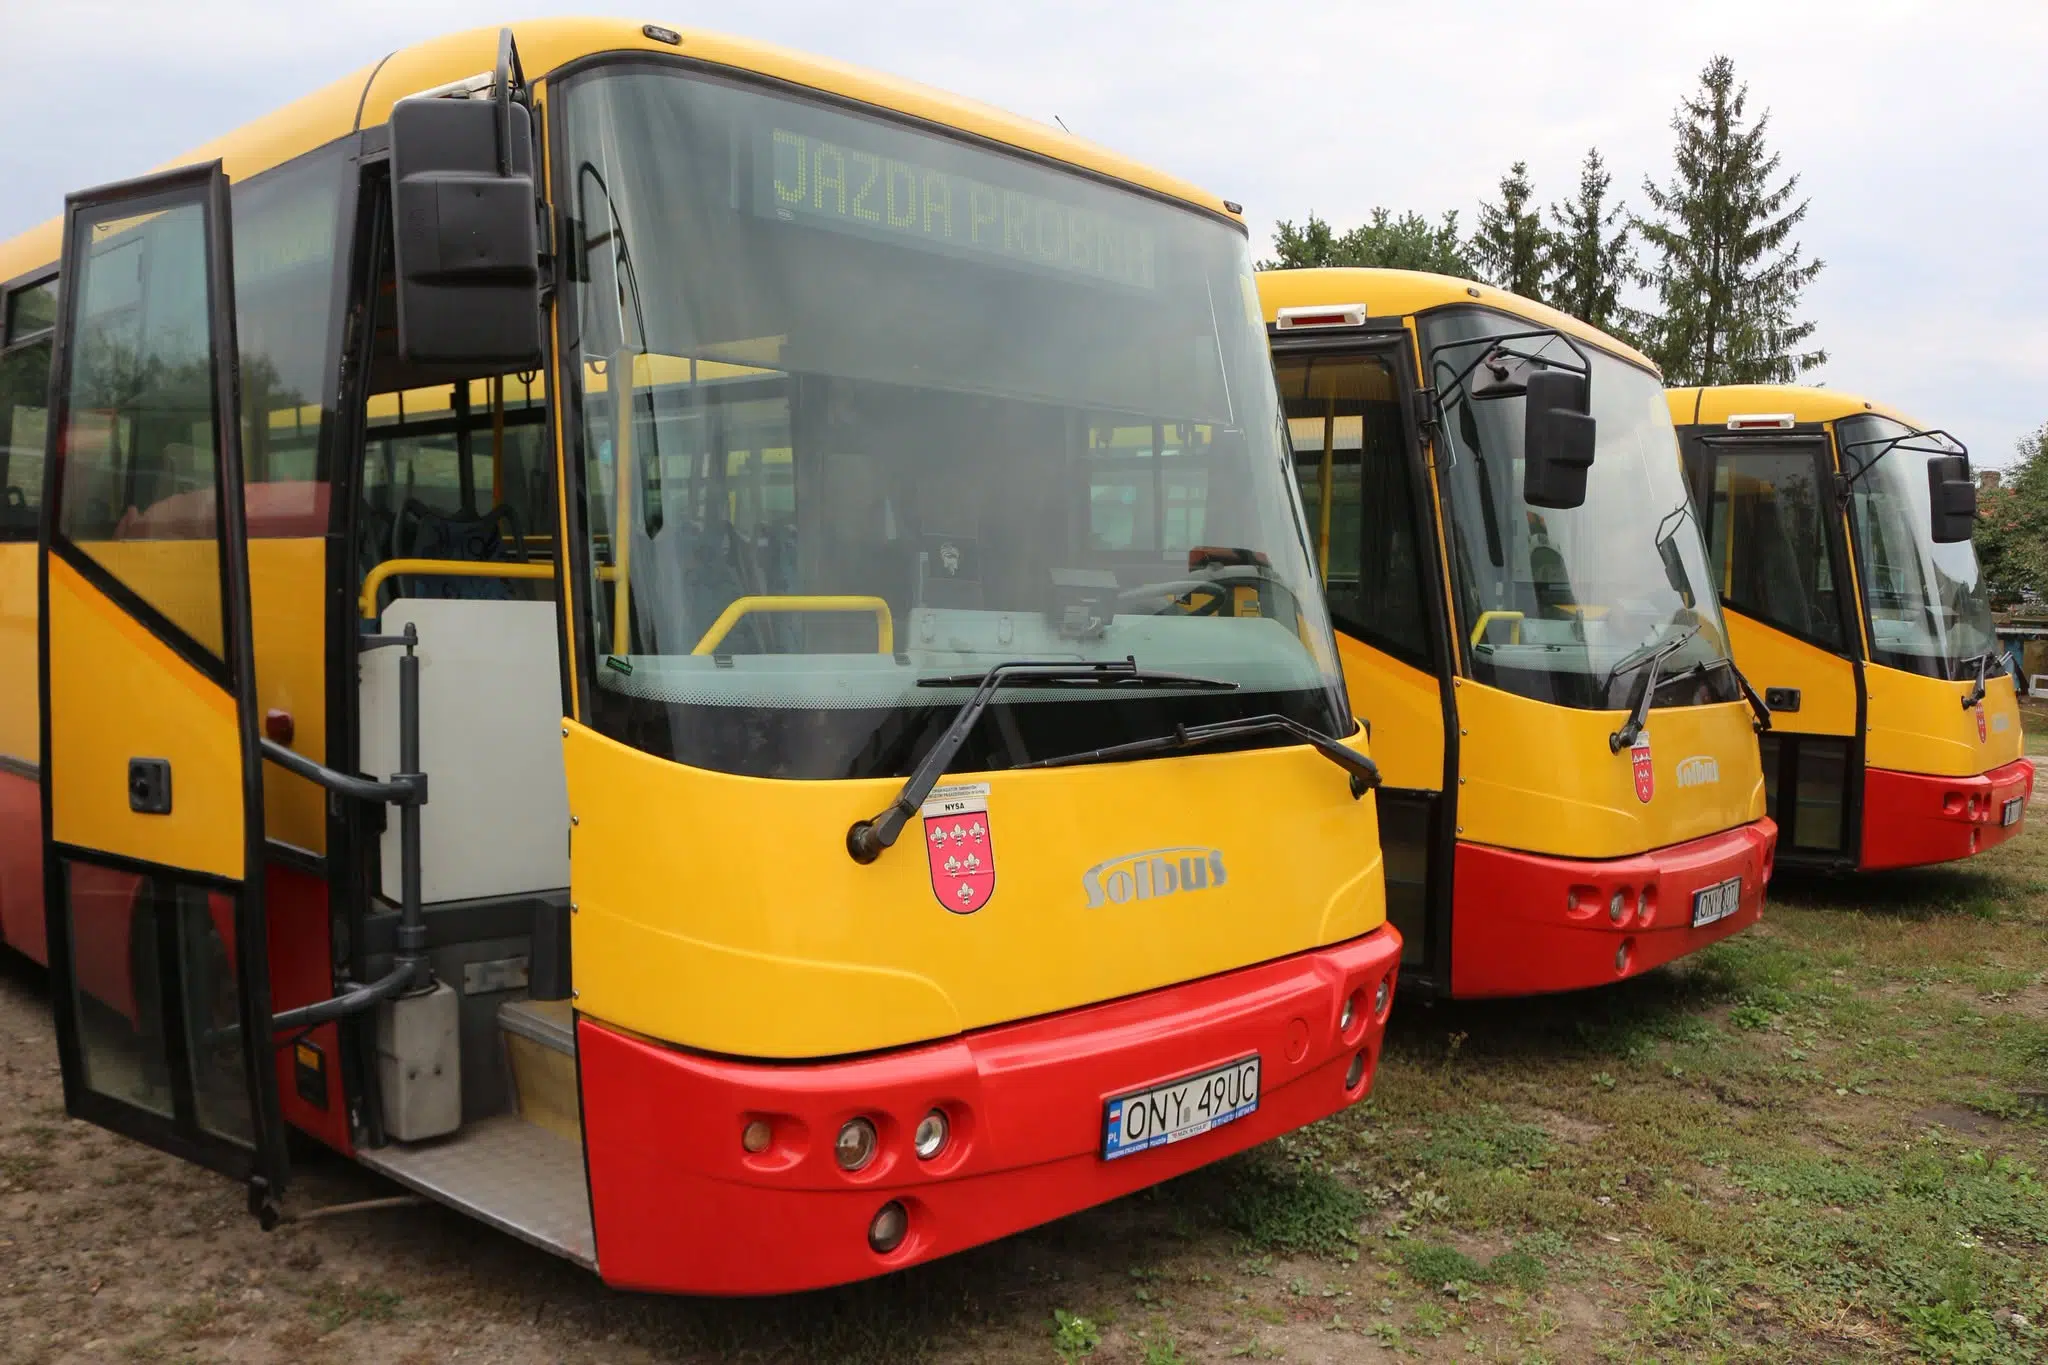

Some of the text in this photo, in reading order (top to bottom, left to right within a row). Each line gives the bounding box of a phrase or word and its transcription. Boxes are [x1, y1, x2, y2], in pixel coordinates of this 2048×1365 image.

[773, 128, 952, 237] JAZDA
[945, 802, 965, 811] NYSA
[1082, 845, 1227, 909] Solbus
[1127, 1088, 1187, 1139] ONY
[1198, 1066, 1255, 1117] 49UC
[1107, 1131, 1118, 1144] PL
